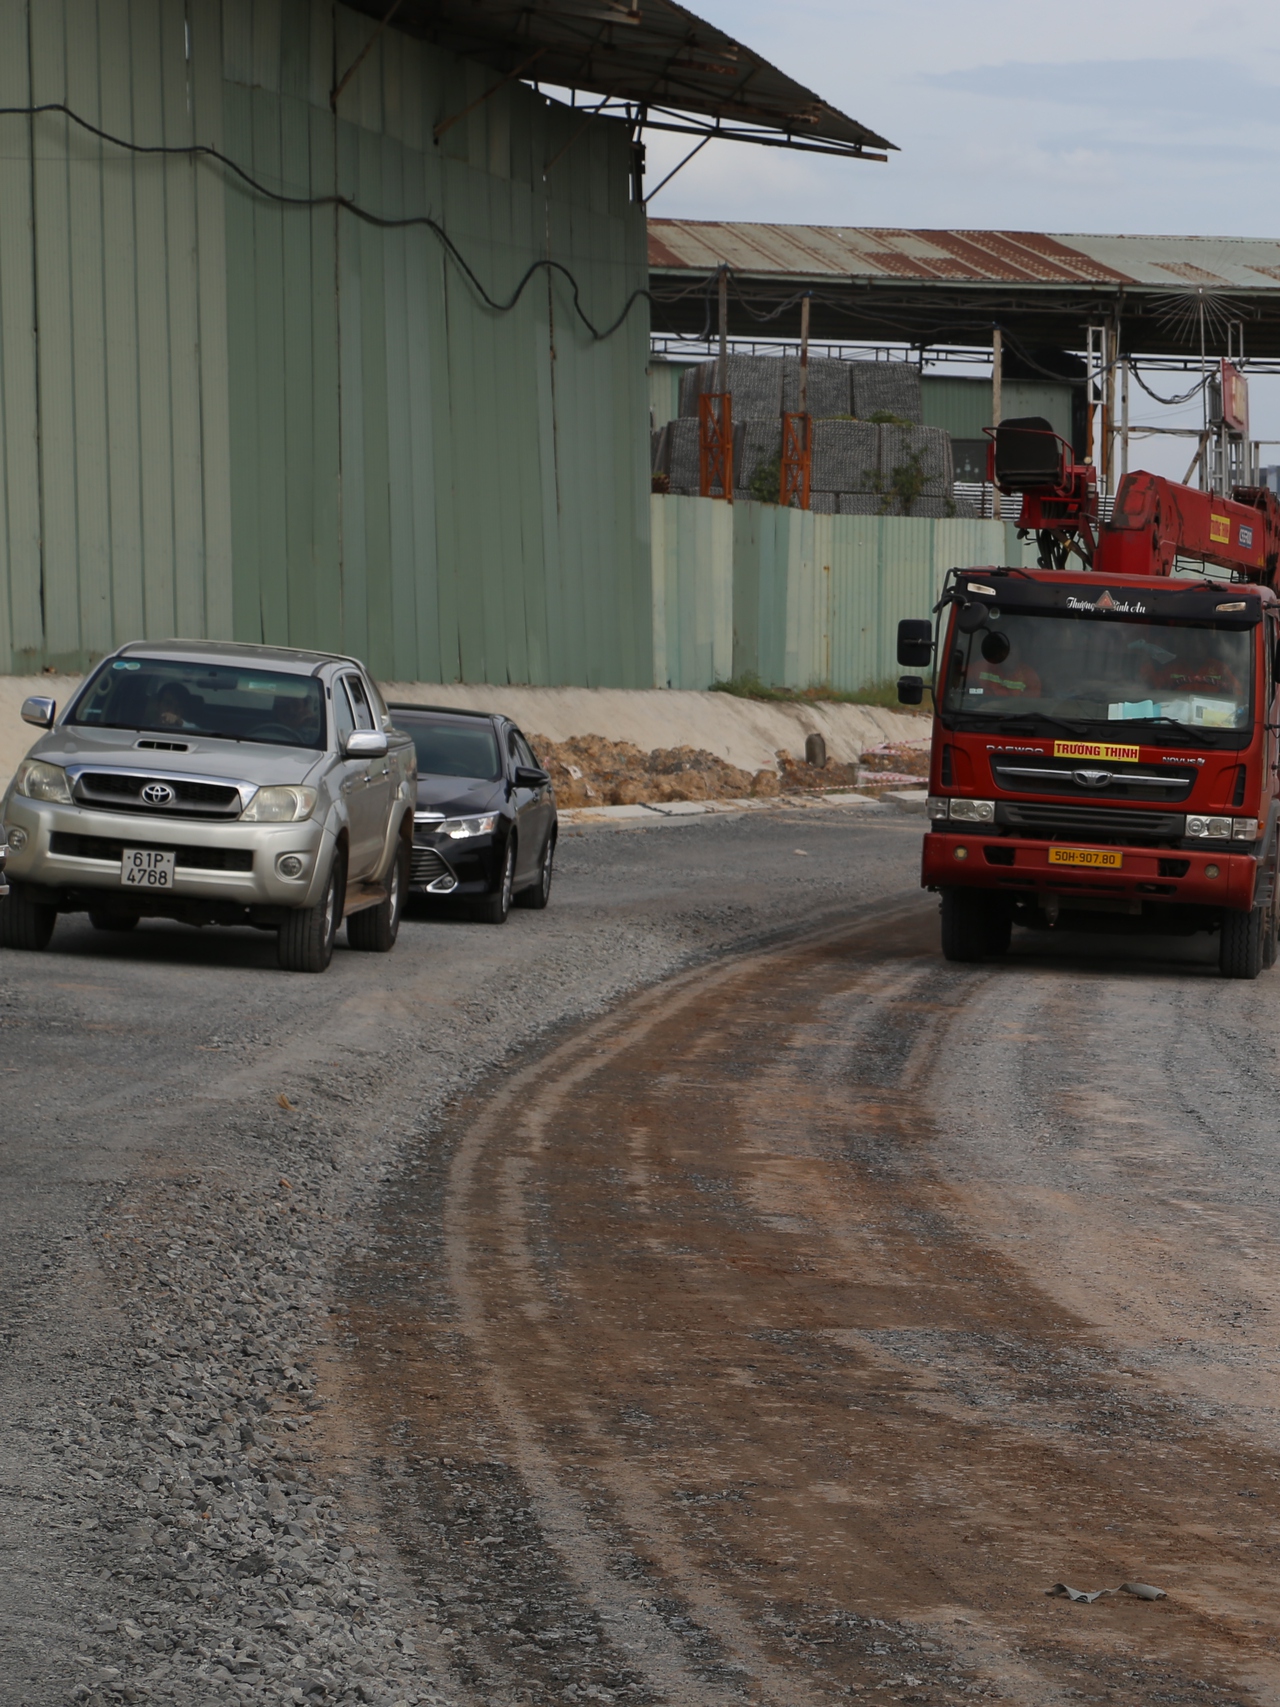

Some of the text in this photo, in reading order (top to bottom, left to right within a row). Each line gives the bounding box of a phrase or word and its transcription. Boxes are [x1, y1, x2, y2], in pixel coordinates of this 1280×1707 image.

[986, 745, 1044, 753] DAEWOO
[1056, 742, 1138, 760] TRƯỜNG THỊNH
[1162, 756, 1197, 764] NOVUS
[1055, 851, 1115, 864] 50H-907.80
[127, 868, 167, 885] 4768
